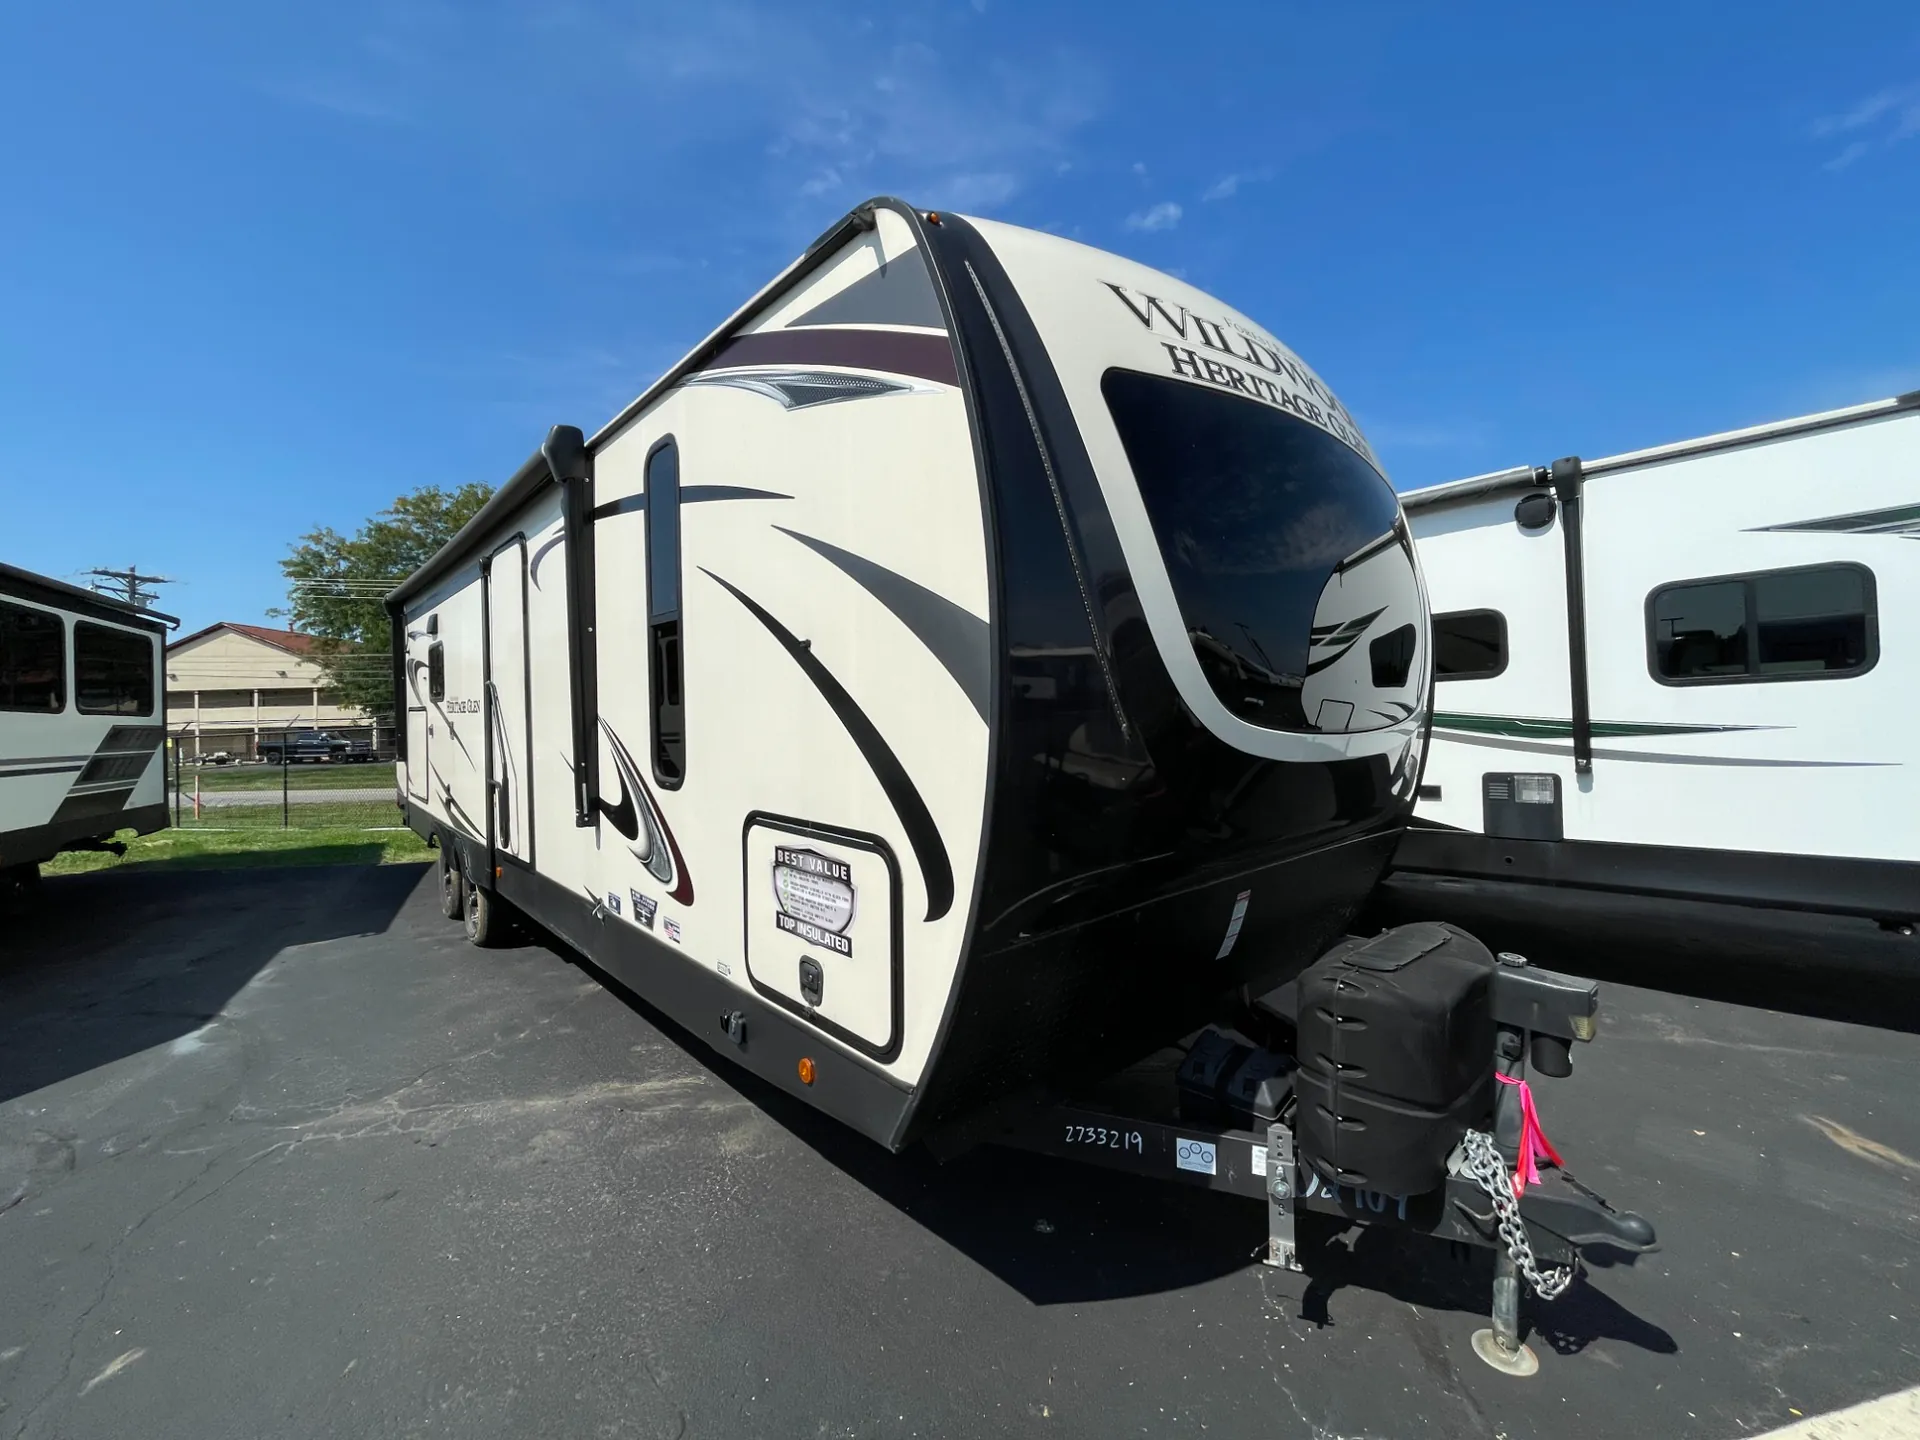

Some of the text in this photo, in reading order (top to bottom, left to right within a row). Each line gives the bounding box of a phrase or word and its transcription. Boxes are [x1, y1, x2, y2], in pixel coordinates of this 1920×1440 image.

[1161, 342, 1329, 430] HERITAGE
[777, 850, 804, 865] BEST
[810, 858, 848, 880] VALUE
[778, 914, 795, 930] TOP
[797, 922, 849, 952] INSULATED
[1065, 1125, 1142, 1154] 2733219
